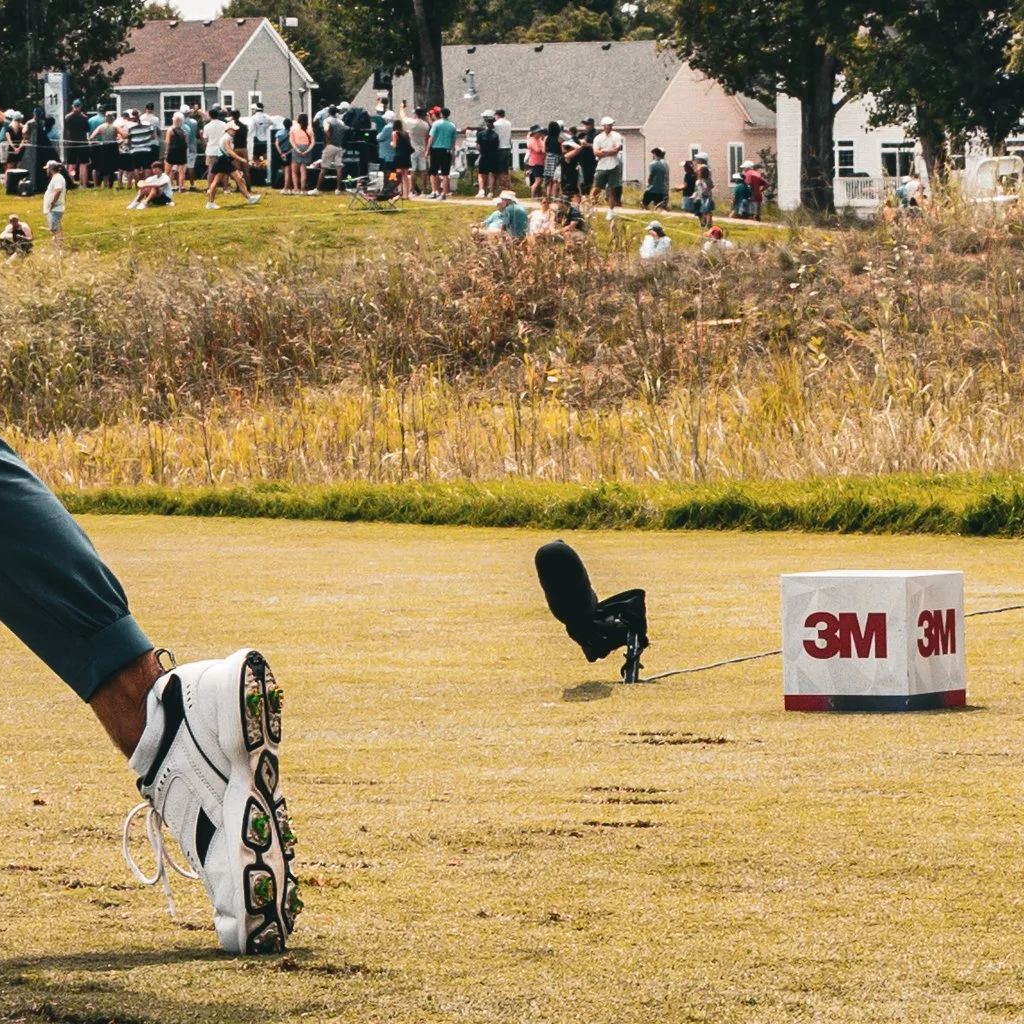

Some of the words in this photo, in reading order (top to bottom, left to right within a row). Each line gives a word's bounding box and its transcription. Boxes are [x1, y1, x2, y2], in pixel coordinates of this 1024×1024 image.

[48, 93, 58, 105] 11
[802, 611, 887, 659] 3M
[917, 608, 957, 658] 3M
